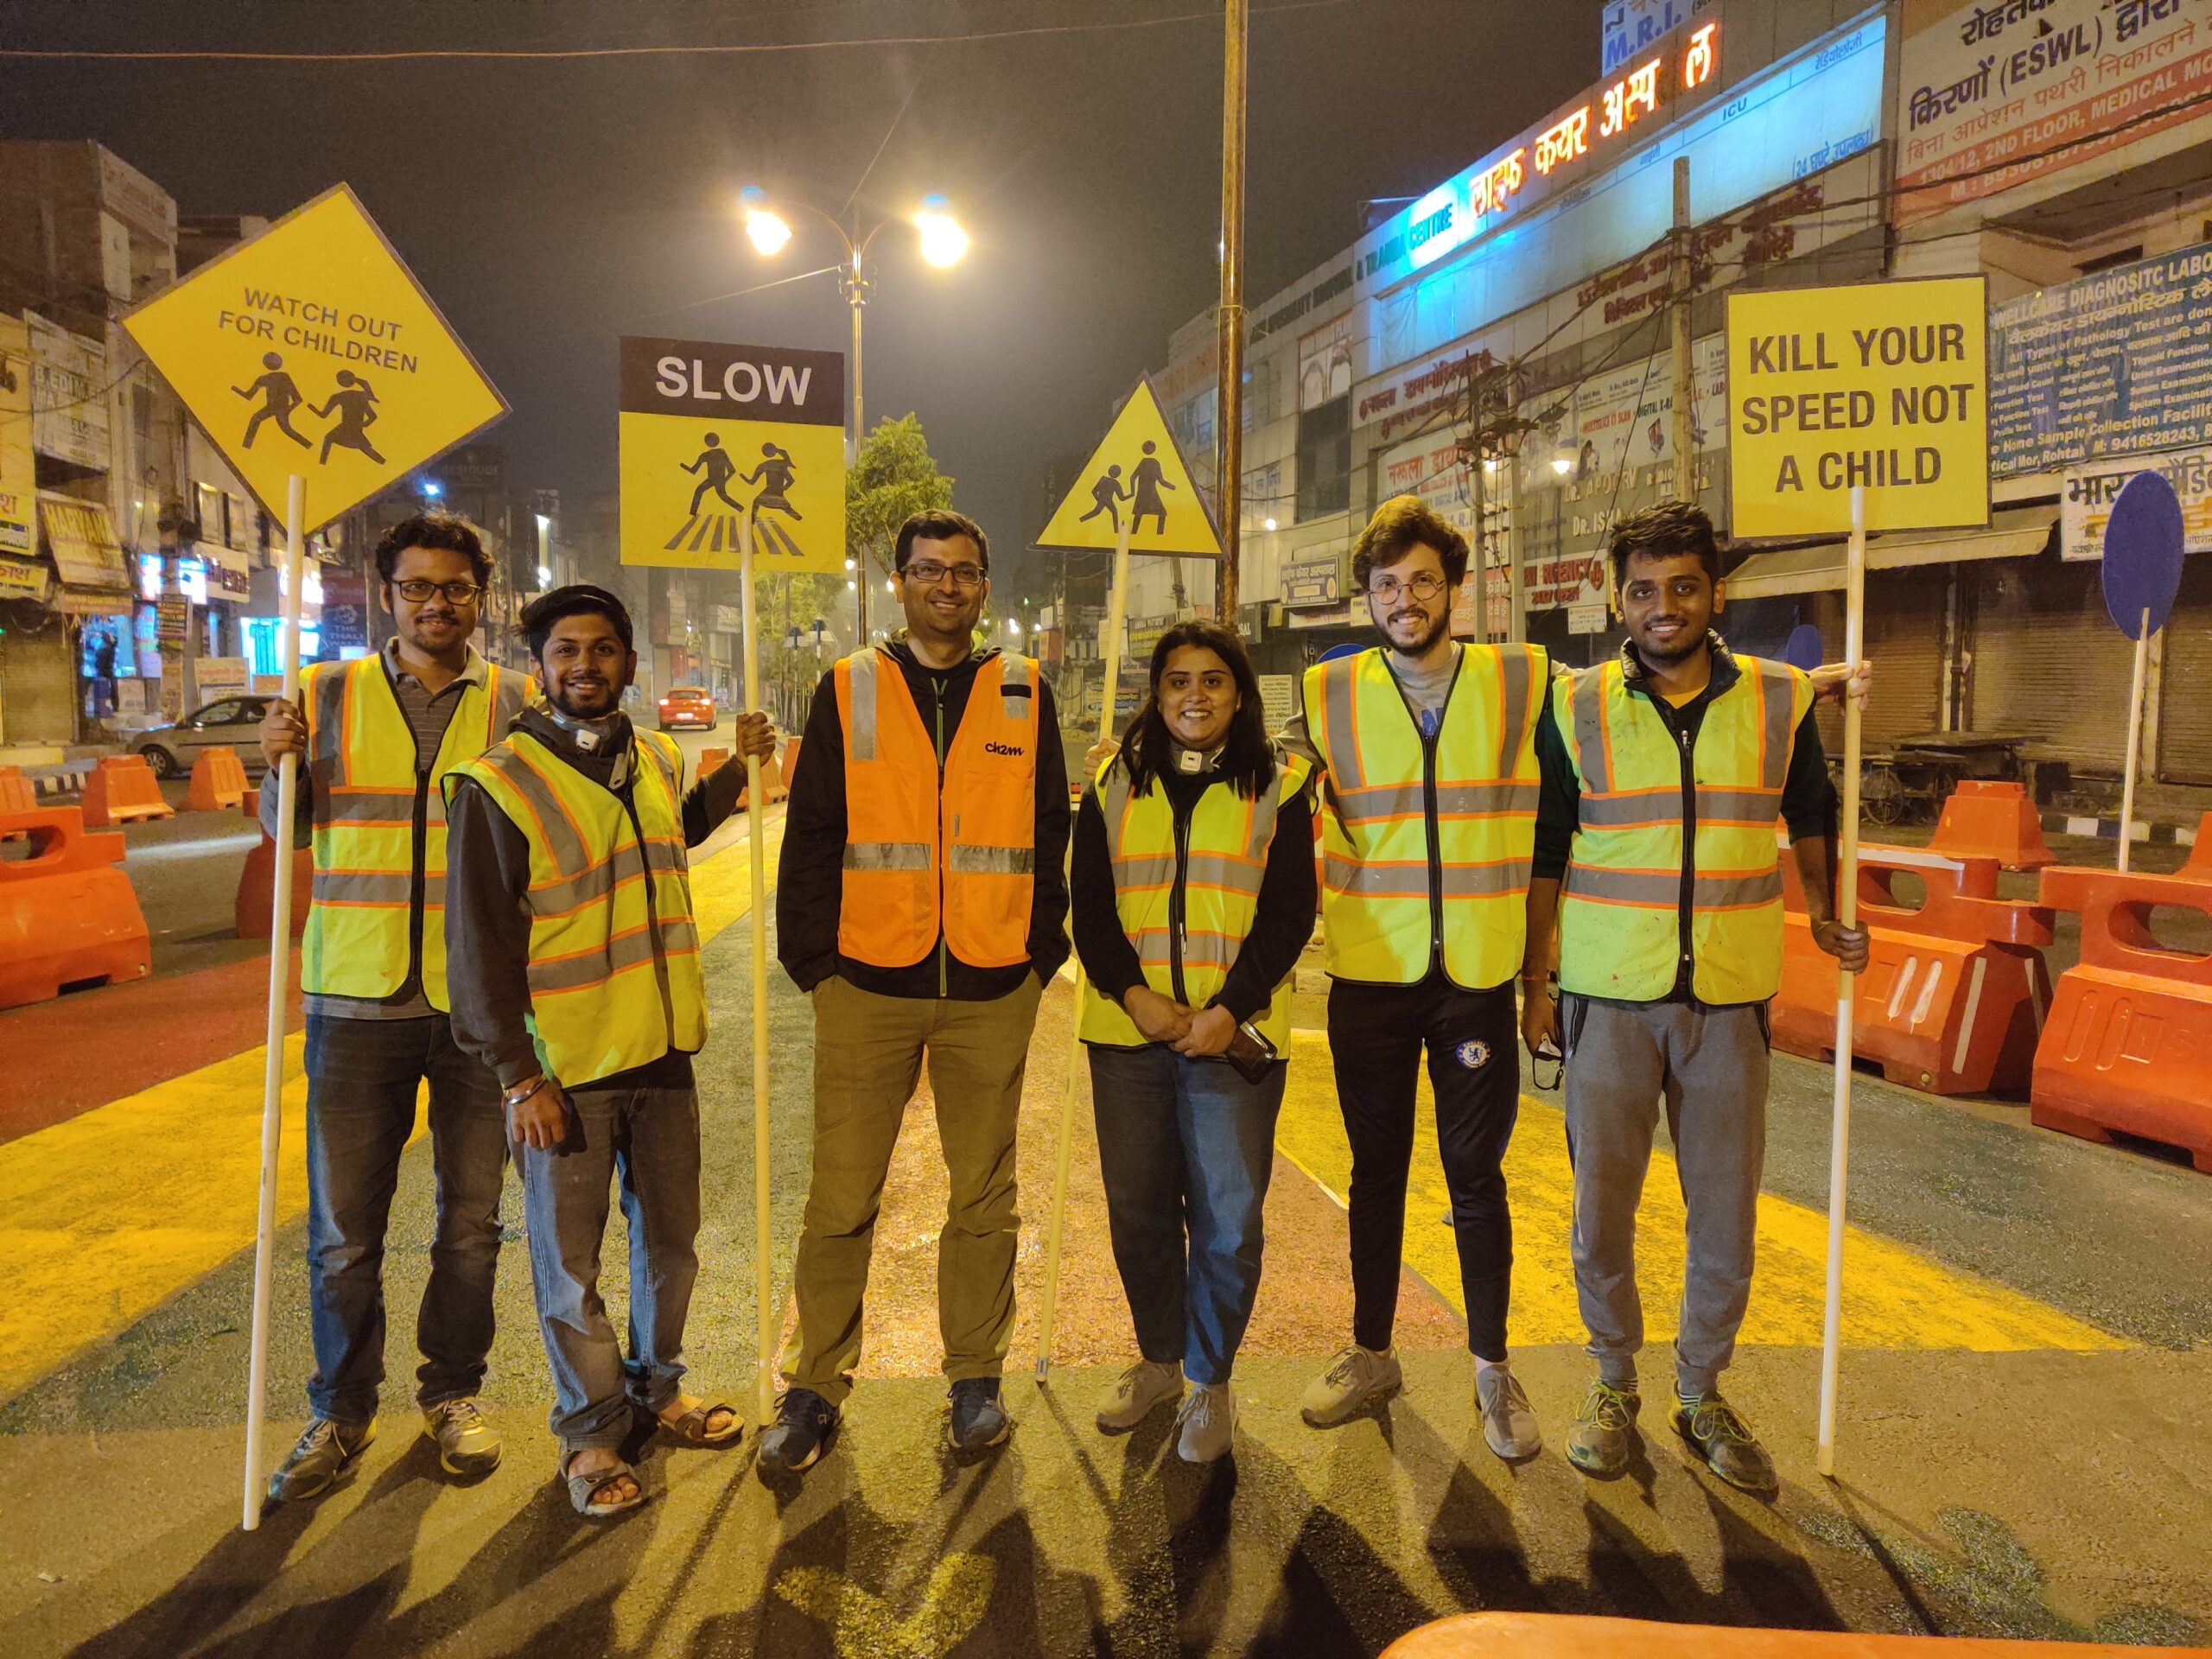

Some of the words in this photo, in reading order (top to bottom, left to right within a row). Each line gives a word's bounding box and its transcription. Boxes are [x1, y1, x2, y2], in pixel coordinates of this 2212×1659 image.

[1909, 54, 1996, 131] किरणों
[2000, 16, 2103, 97] (ESWL)
[1722, 97, 1748, 122] ICU
[1907, 132, 1947, 164] बिना
[2033, 66, 2087, 108] पथरी
[1986, 135, 2018, 162] 2ND
[2022, 109, 2086, 148] FLOOR,
[2090, 70, 2177, 121] MEDICAL
[245, 286, 339, 327] WATCH
[346, 313, 403, 342] OUT
[2074, 326, 2131, 347] Pathology
[2134, 316, 2161, 333] Test
[2164, 312, 2184, 327] are
[219, 309, 275, 341] FOR
[283, 326, 418, 374] CHILDREN
[1749, 332, 1839, 374] KILL
[1853, 322, 1965, 367] YOUR
[656, 356, 812, 406] SLOW
[1742, 390, 1876, 435] SPEED
[1891, 383, 1975, 425] NOT
[1775, 454, 1804, 493] A
[1818, 446, 1942, 491] CHILD
[984, 741, 1025, 757] ch2m
